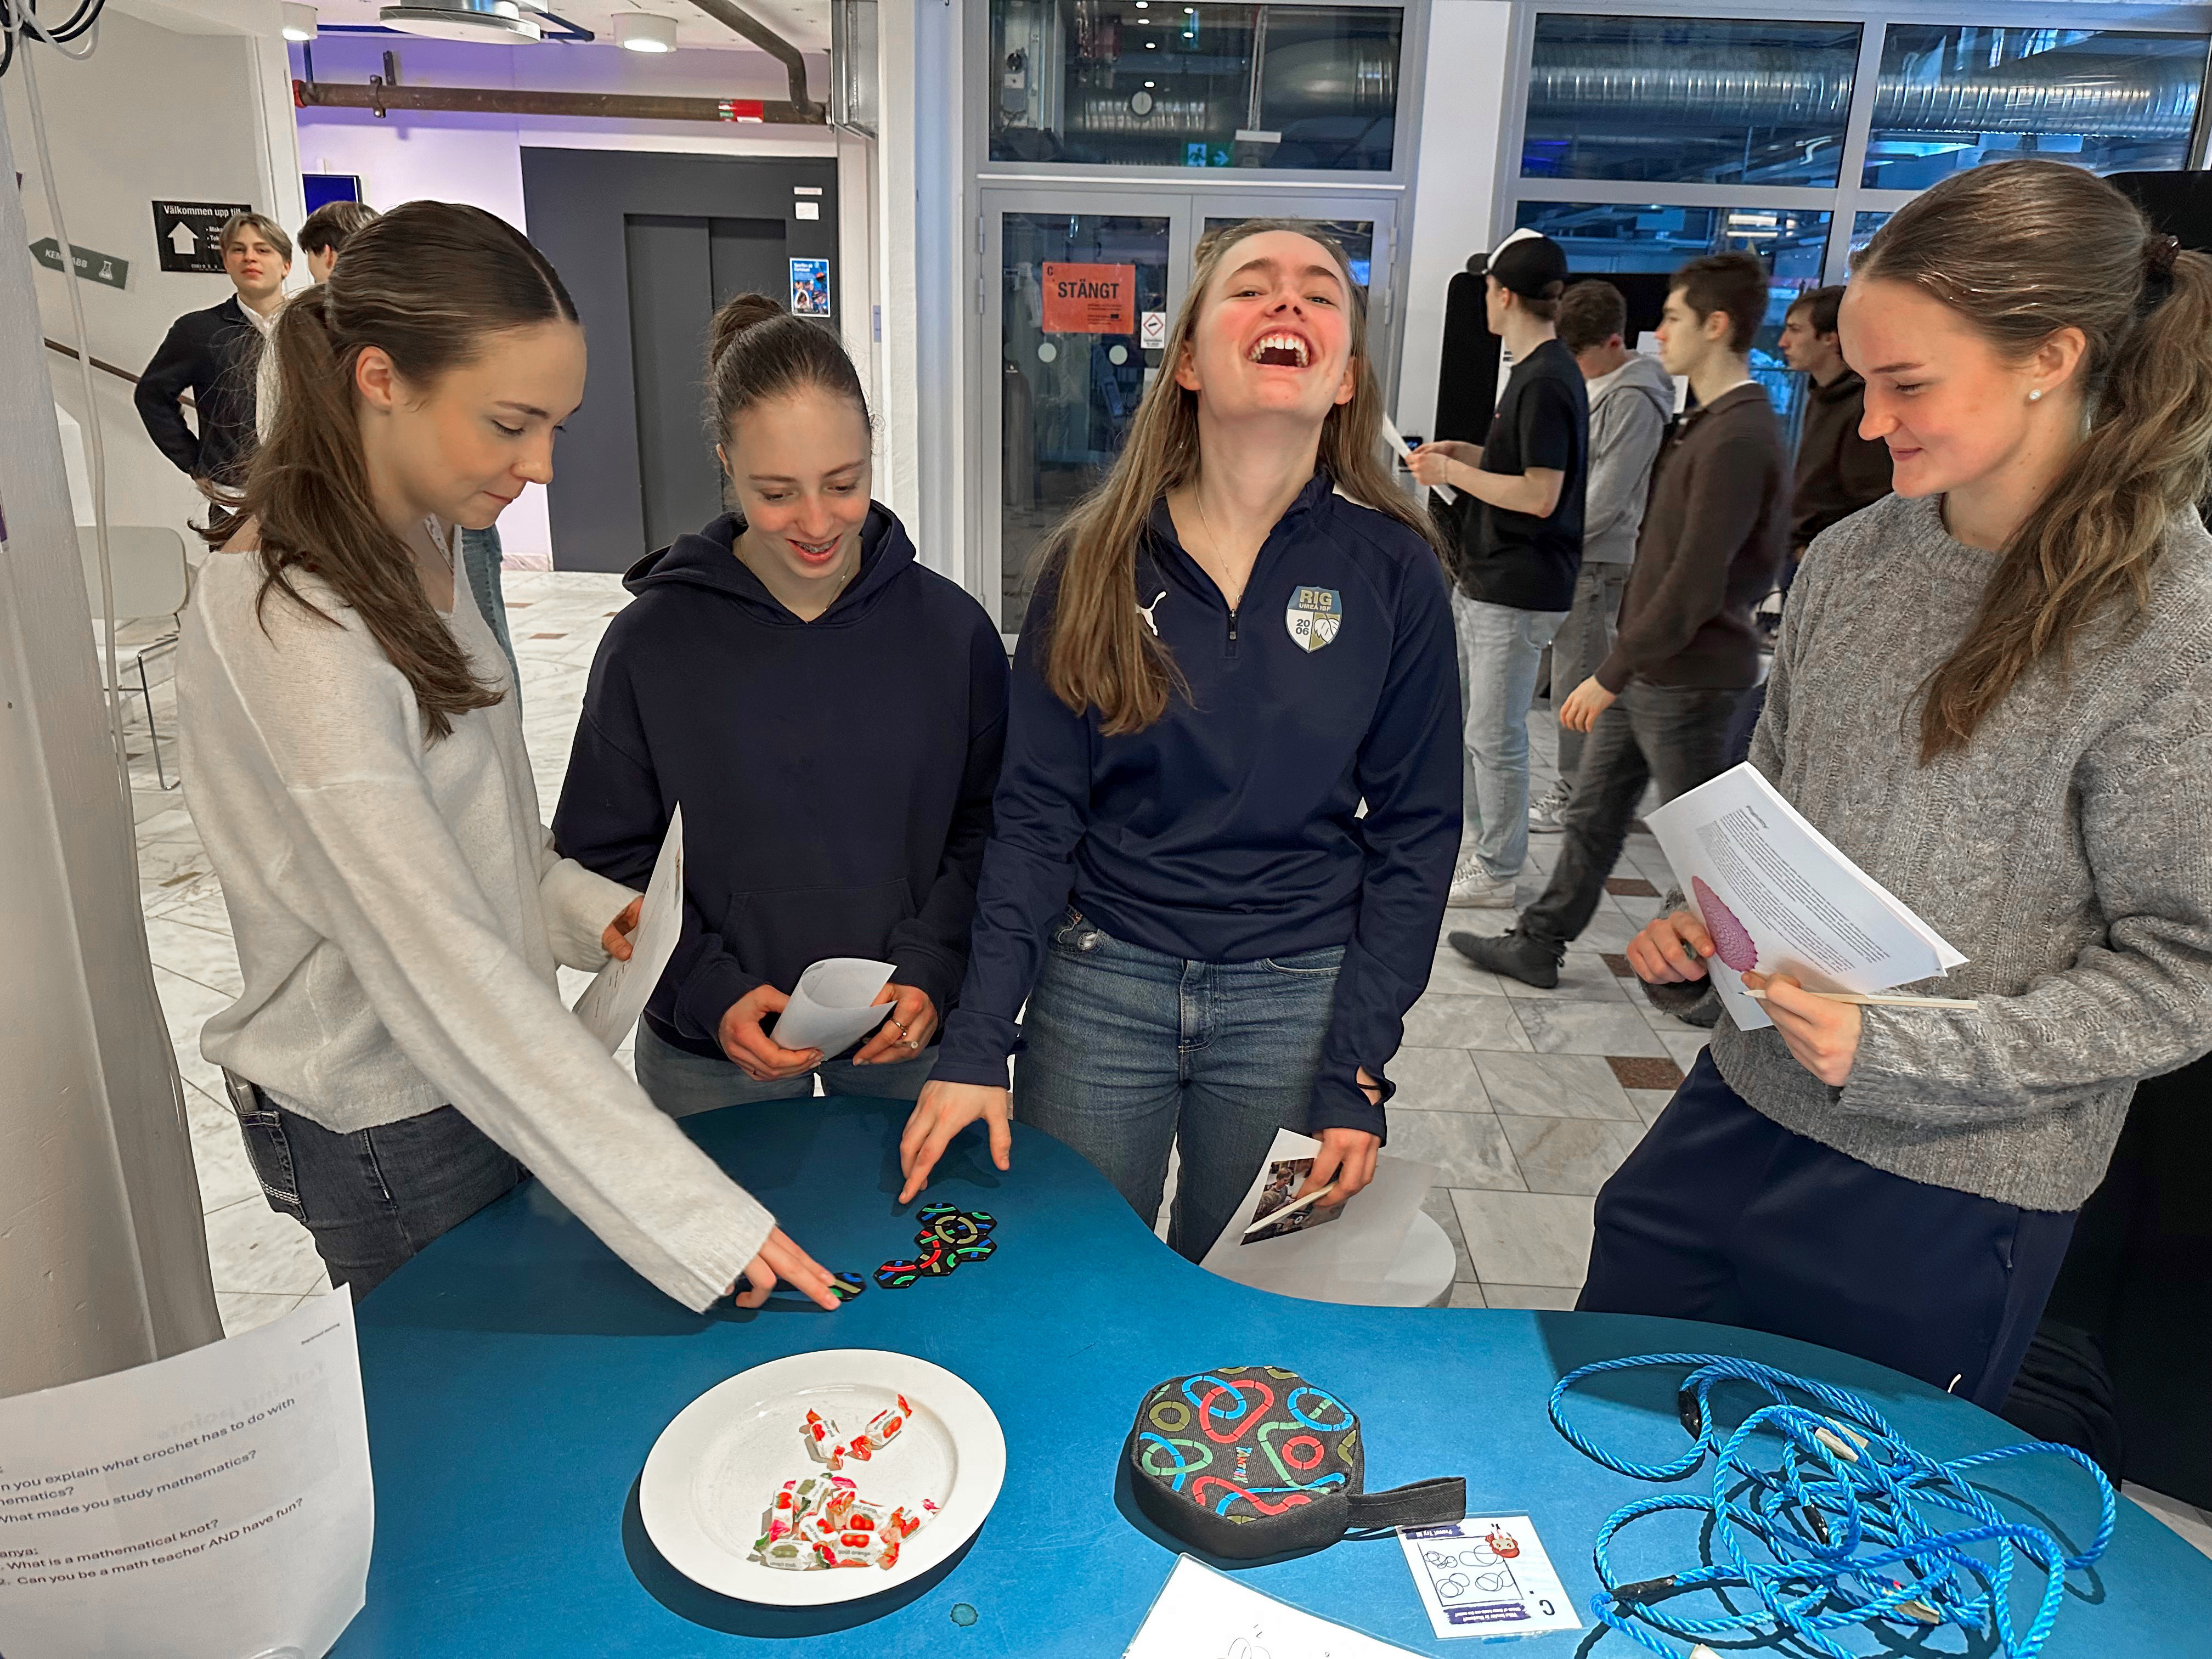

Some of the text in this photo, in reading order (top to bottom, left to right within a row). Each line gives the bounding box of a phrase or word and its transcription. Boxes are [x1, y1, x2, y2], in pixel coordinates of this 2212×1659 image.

[164, 205, 213, 216] Välkommen
[215, 208, 229, 218] upp
[1047, 266, 1053, 276] C
[1058, 279, 1120, 299] STÄNGT
[1300, 589, 1332, 606] RIG
[1295, 627, 1310, 636] 06
[1296, 619, 1311, 627] 20
[13, 1479, 41, 1491] you
[45, 1466, 99, 1483] explain
[102, 1456, 140, 1472] what
[143, 1438, 200, 1462] crochet
[201, 1428, 228, 1443] has
[230, 1421, 245, 1432] to
[248, 1412, 266, 1424] do
[267, 1398, 295, 1415] with
[37, 1505, 80, 1519] made
[82, 1499, 110, 1512] you
[112, 1488, 154, 1504] study
[156, 1449, 257, 1493] mathematics?
[7, 1560, 46, 1570] What
[48, 1558, 61, 1566] is
[77, 1533, 177, 1562] mathematical
[179, 1519, 219, 1539] knot?
[17, 1576, 47, 1585] Can
[50, 1574, 75, 1584] you
[78, 1571, 97, 1579] be
[111, 1560, 149, 1574] math
[151, 1544, 206, 1565] teacher
[208, 1530, 240, 1549] AND
[242, 1515, 274, 1534] have
[276, 1498, 303, 1519] fun?
[0, 1548, 38, 1558] anya:
